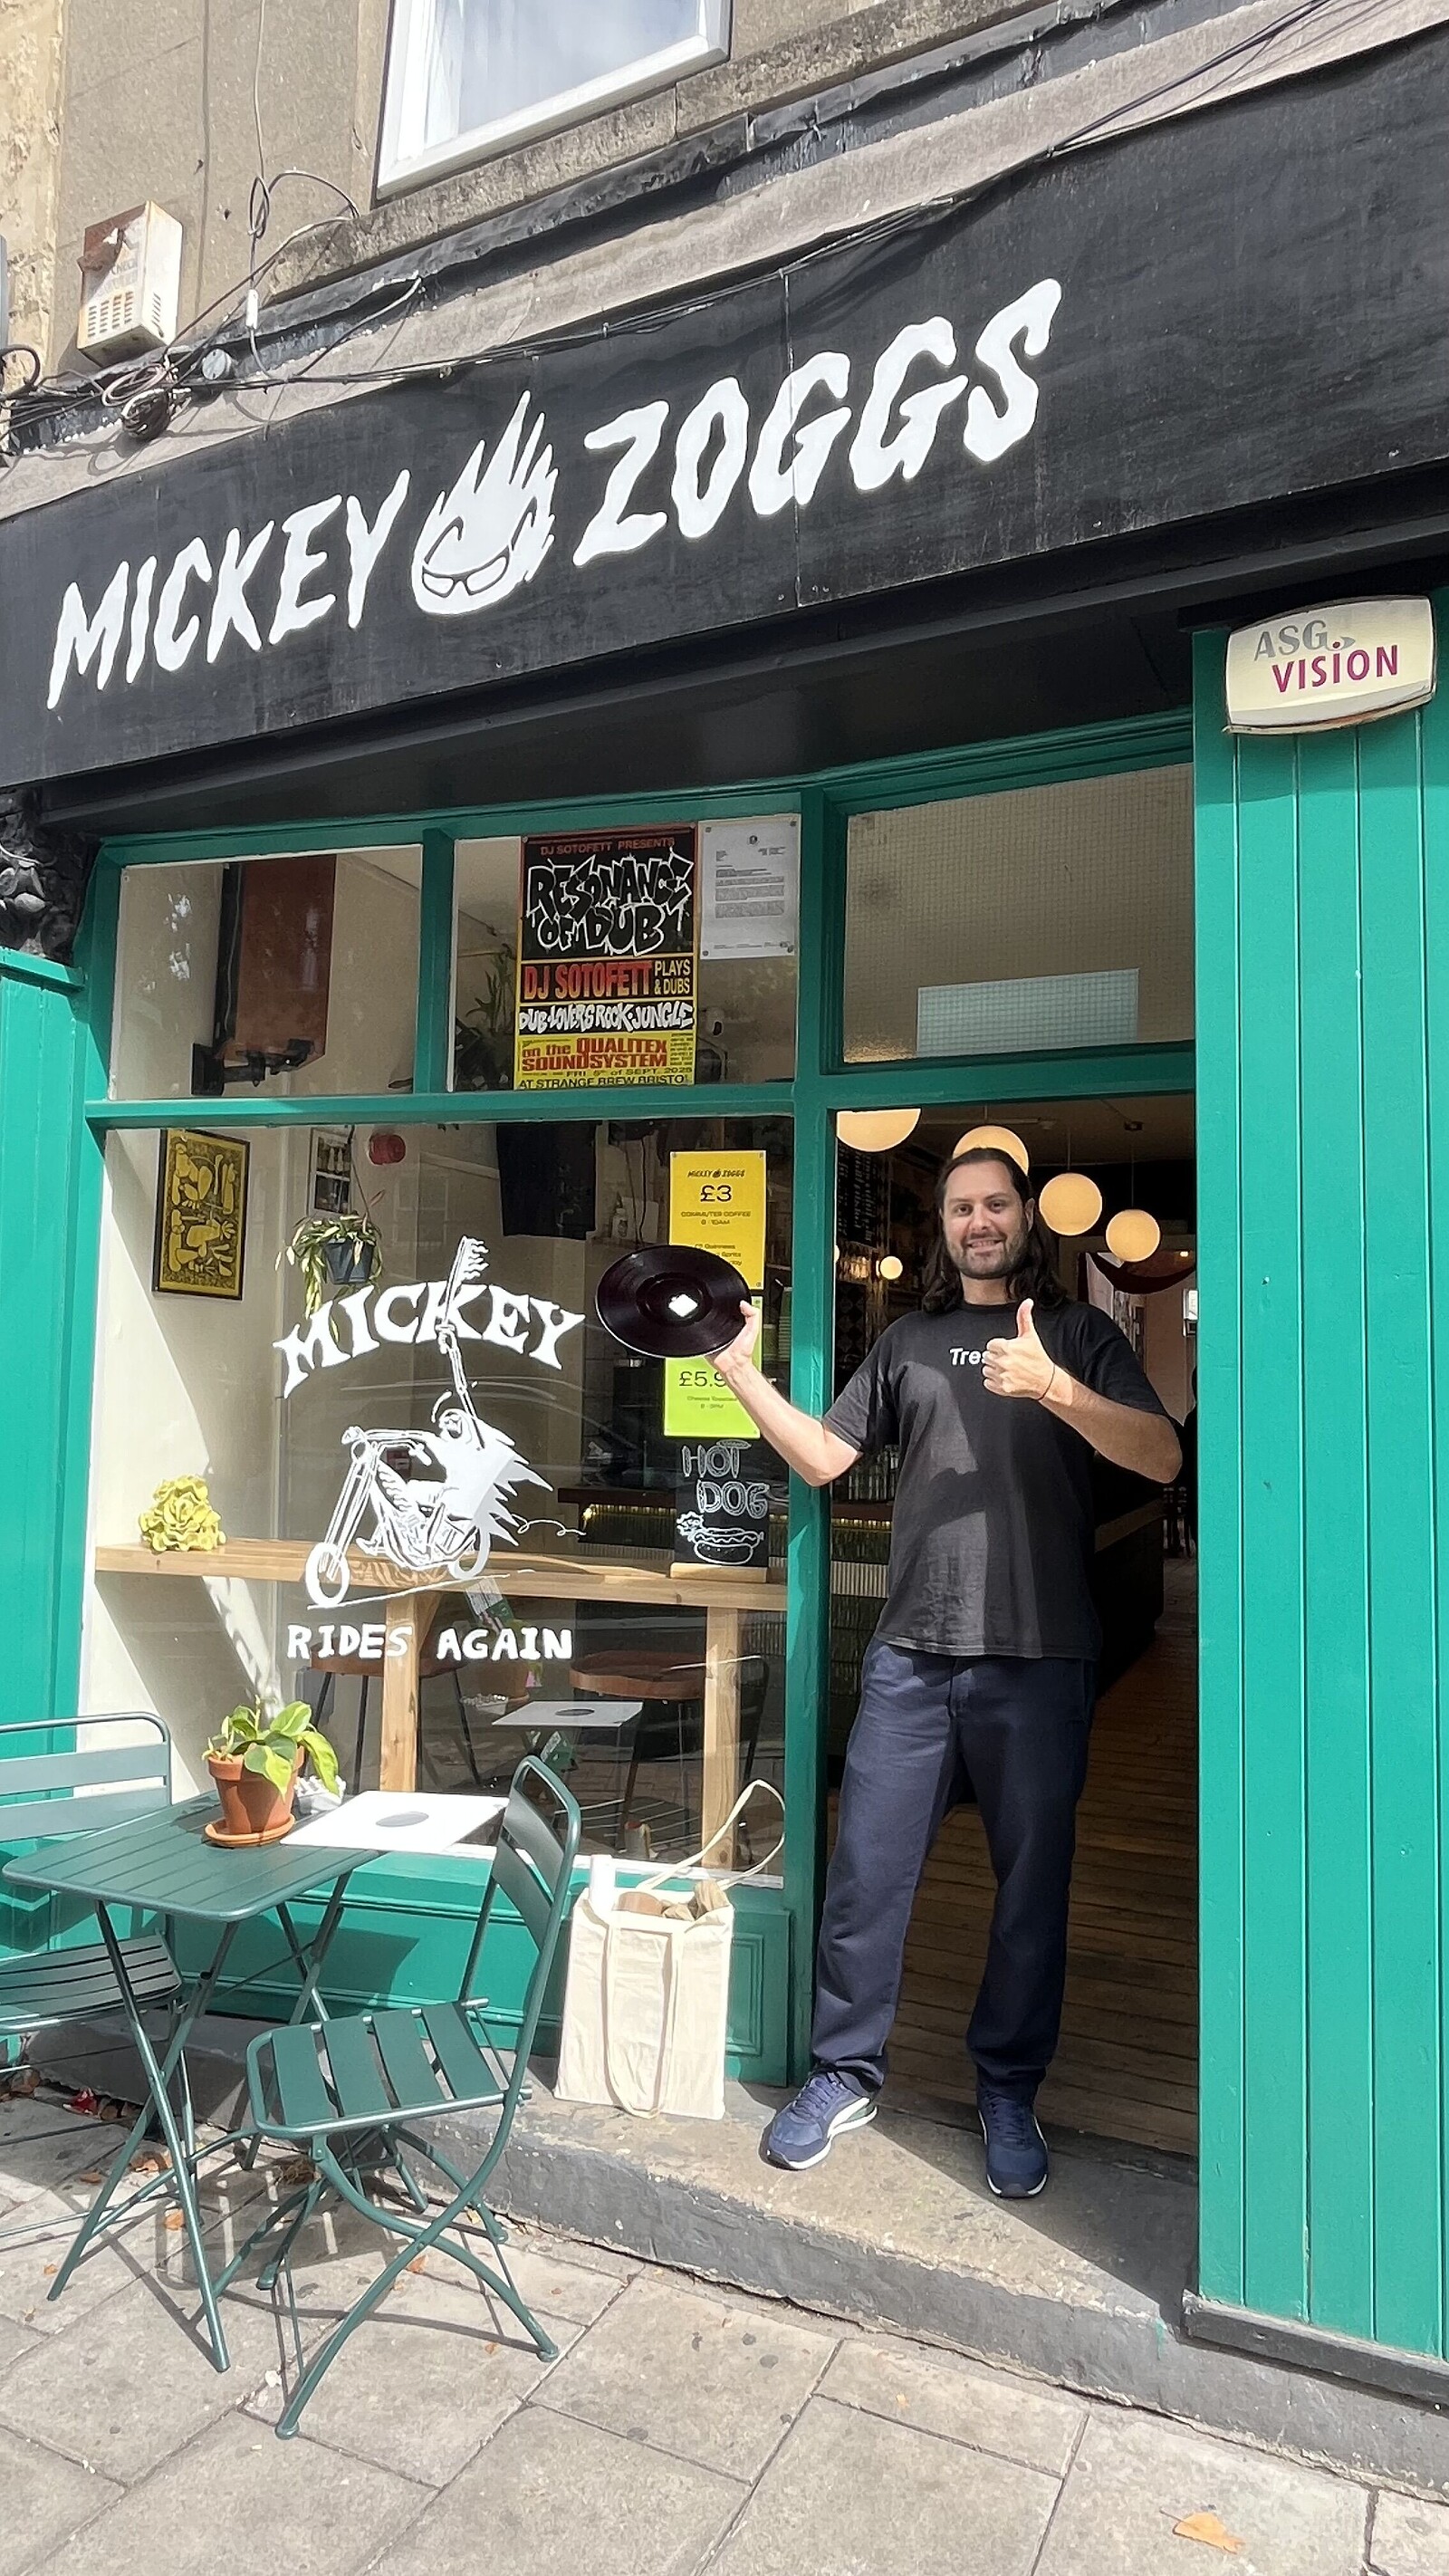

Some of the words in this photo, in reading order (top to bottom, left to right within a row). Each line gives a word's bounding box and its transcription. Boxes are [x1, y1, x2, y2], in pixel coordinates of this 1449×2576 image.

[47, 469, 410, 710] MICKEY
[573, 279, 1061, 566] ZOGGS
[1254, 620, 1329, 661] ASG
[1271, 641, 1398, 693] VISION
[540, 847, 554, 855] DJ
[556, 841, 612, 854] SOTOFETT
[618, 837, 675, 850] PRESENTS
[526, 851, 694, 924] RESONANCE
[538, 915, 579, 951] OF
[584, 904, 666, 956] DUB
[523, 965, 550, 1000] DJ
[554, 960, 653, 999] SOTOFETT
[654, 958, 690, 976] PLAYS
[654, 980, 661, 995] &
[663, 977, 690, 995] DUBS
[523, 1047, 541, 1058] on
[546, 1043, 571, 1056] the
[576, 1037, 667, 1053] QUALITEX
[519, 1080, 532, 1088] AT
[536, 1077, 594, 1088] STRANGE
[700, 1185, 733, 1202] £3
[273, 1282, 586, 1399] MICKEY
[679, 1370, 726, 1387] £5.9
[682, 1439, 752, 1477] HOT
[696, 1478, 770, 1519] DOG
[287, 1624, 413, 1659] RIDES
[437, 1628, 572, 1660] AGAIN
